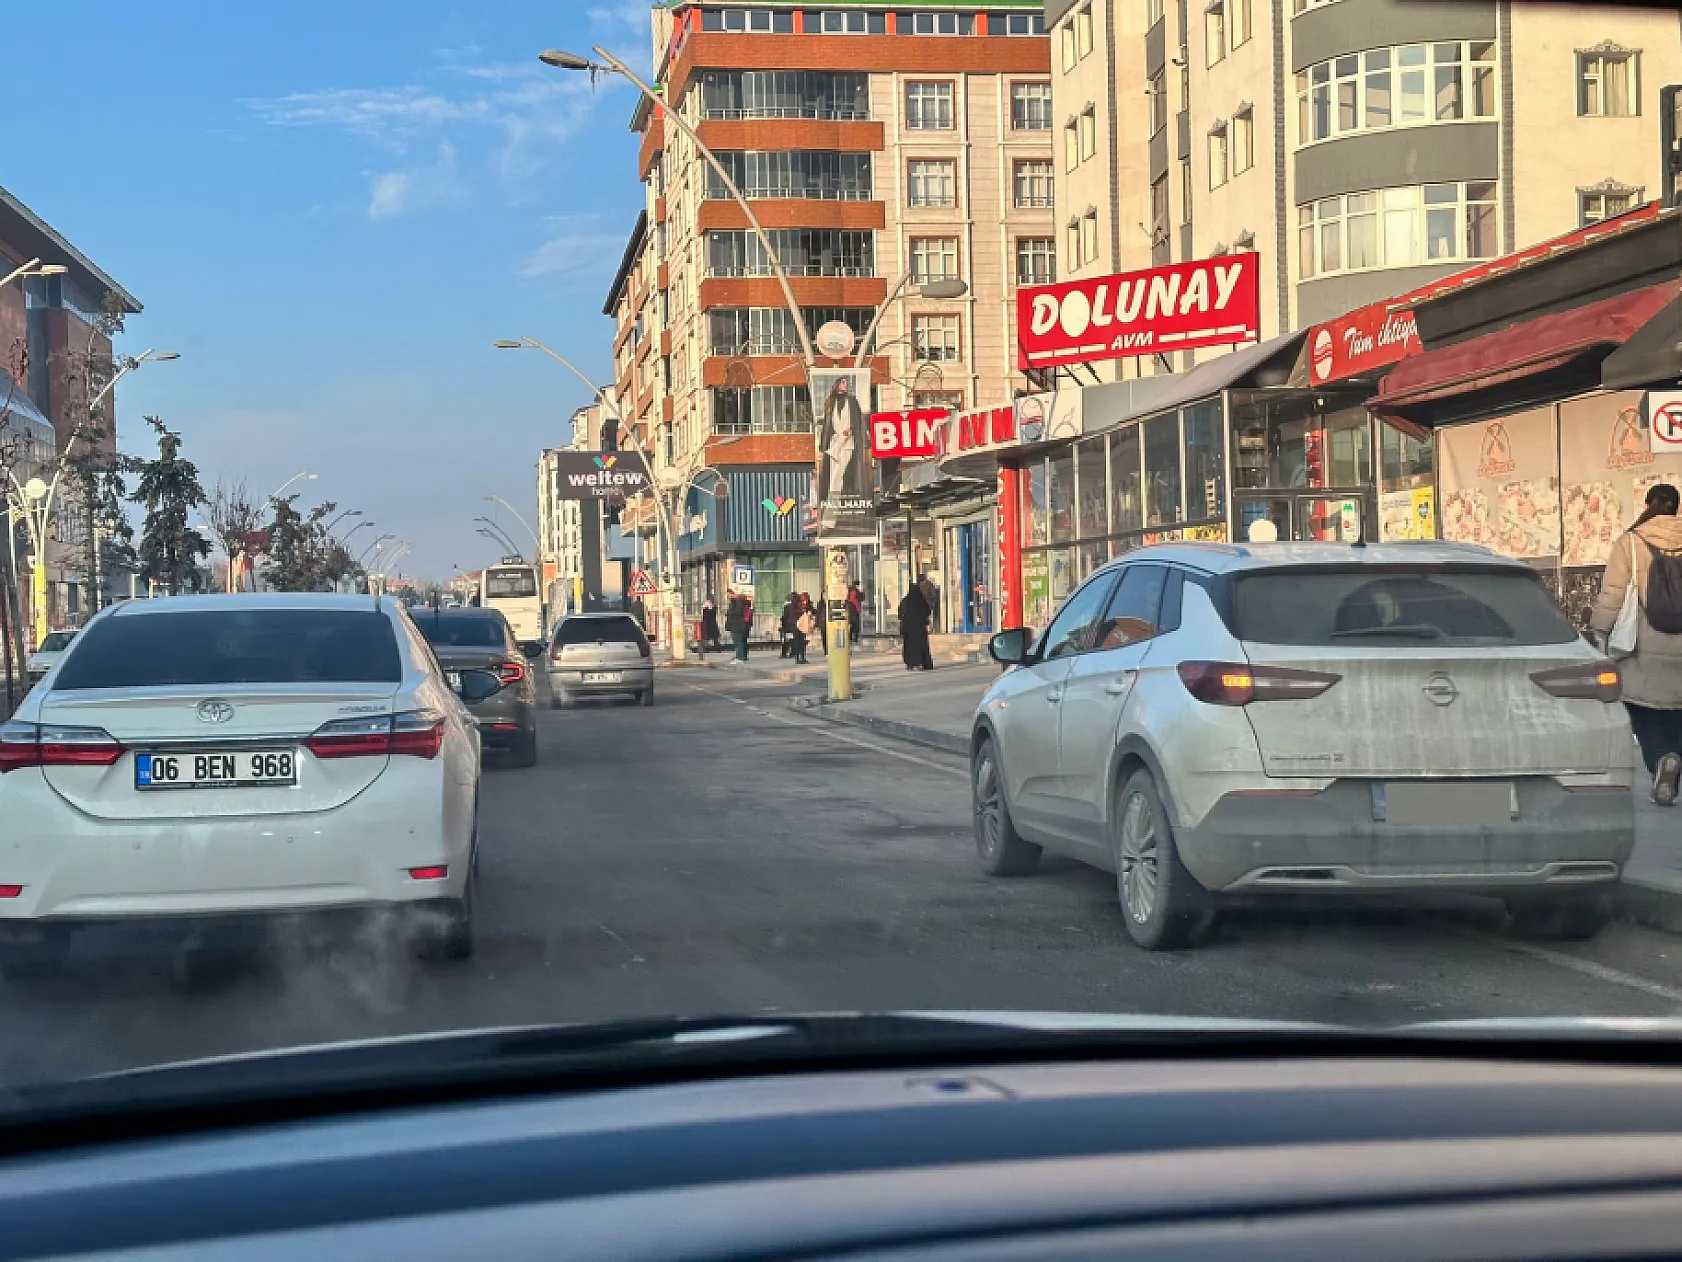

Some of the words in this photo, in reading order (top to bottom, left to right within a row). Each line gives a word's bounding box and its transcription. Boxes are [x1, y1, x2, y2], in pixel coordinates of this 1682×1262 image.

[1030, 263, 1243, 337] DOLUNAY
[1111, 330, 1153, 350] AVM
[1378, 313, 1418, 348] ihtiya
[568, 470, 642, 487] weltew
[152, 757, 179, 781] 06
[194, 755, 236, 779] BEN
[251, 753, 292, 777] 968
